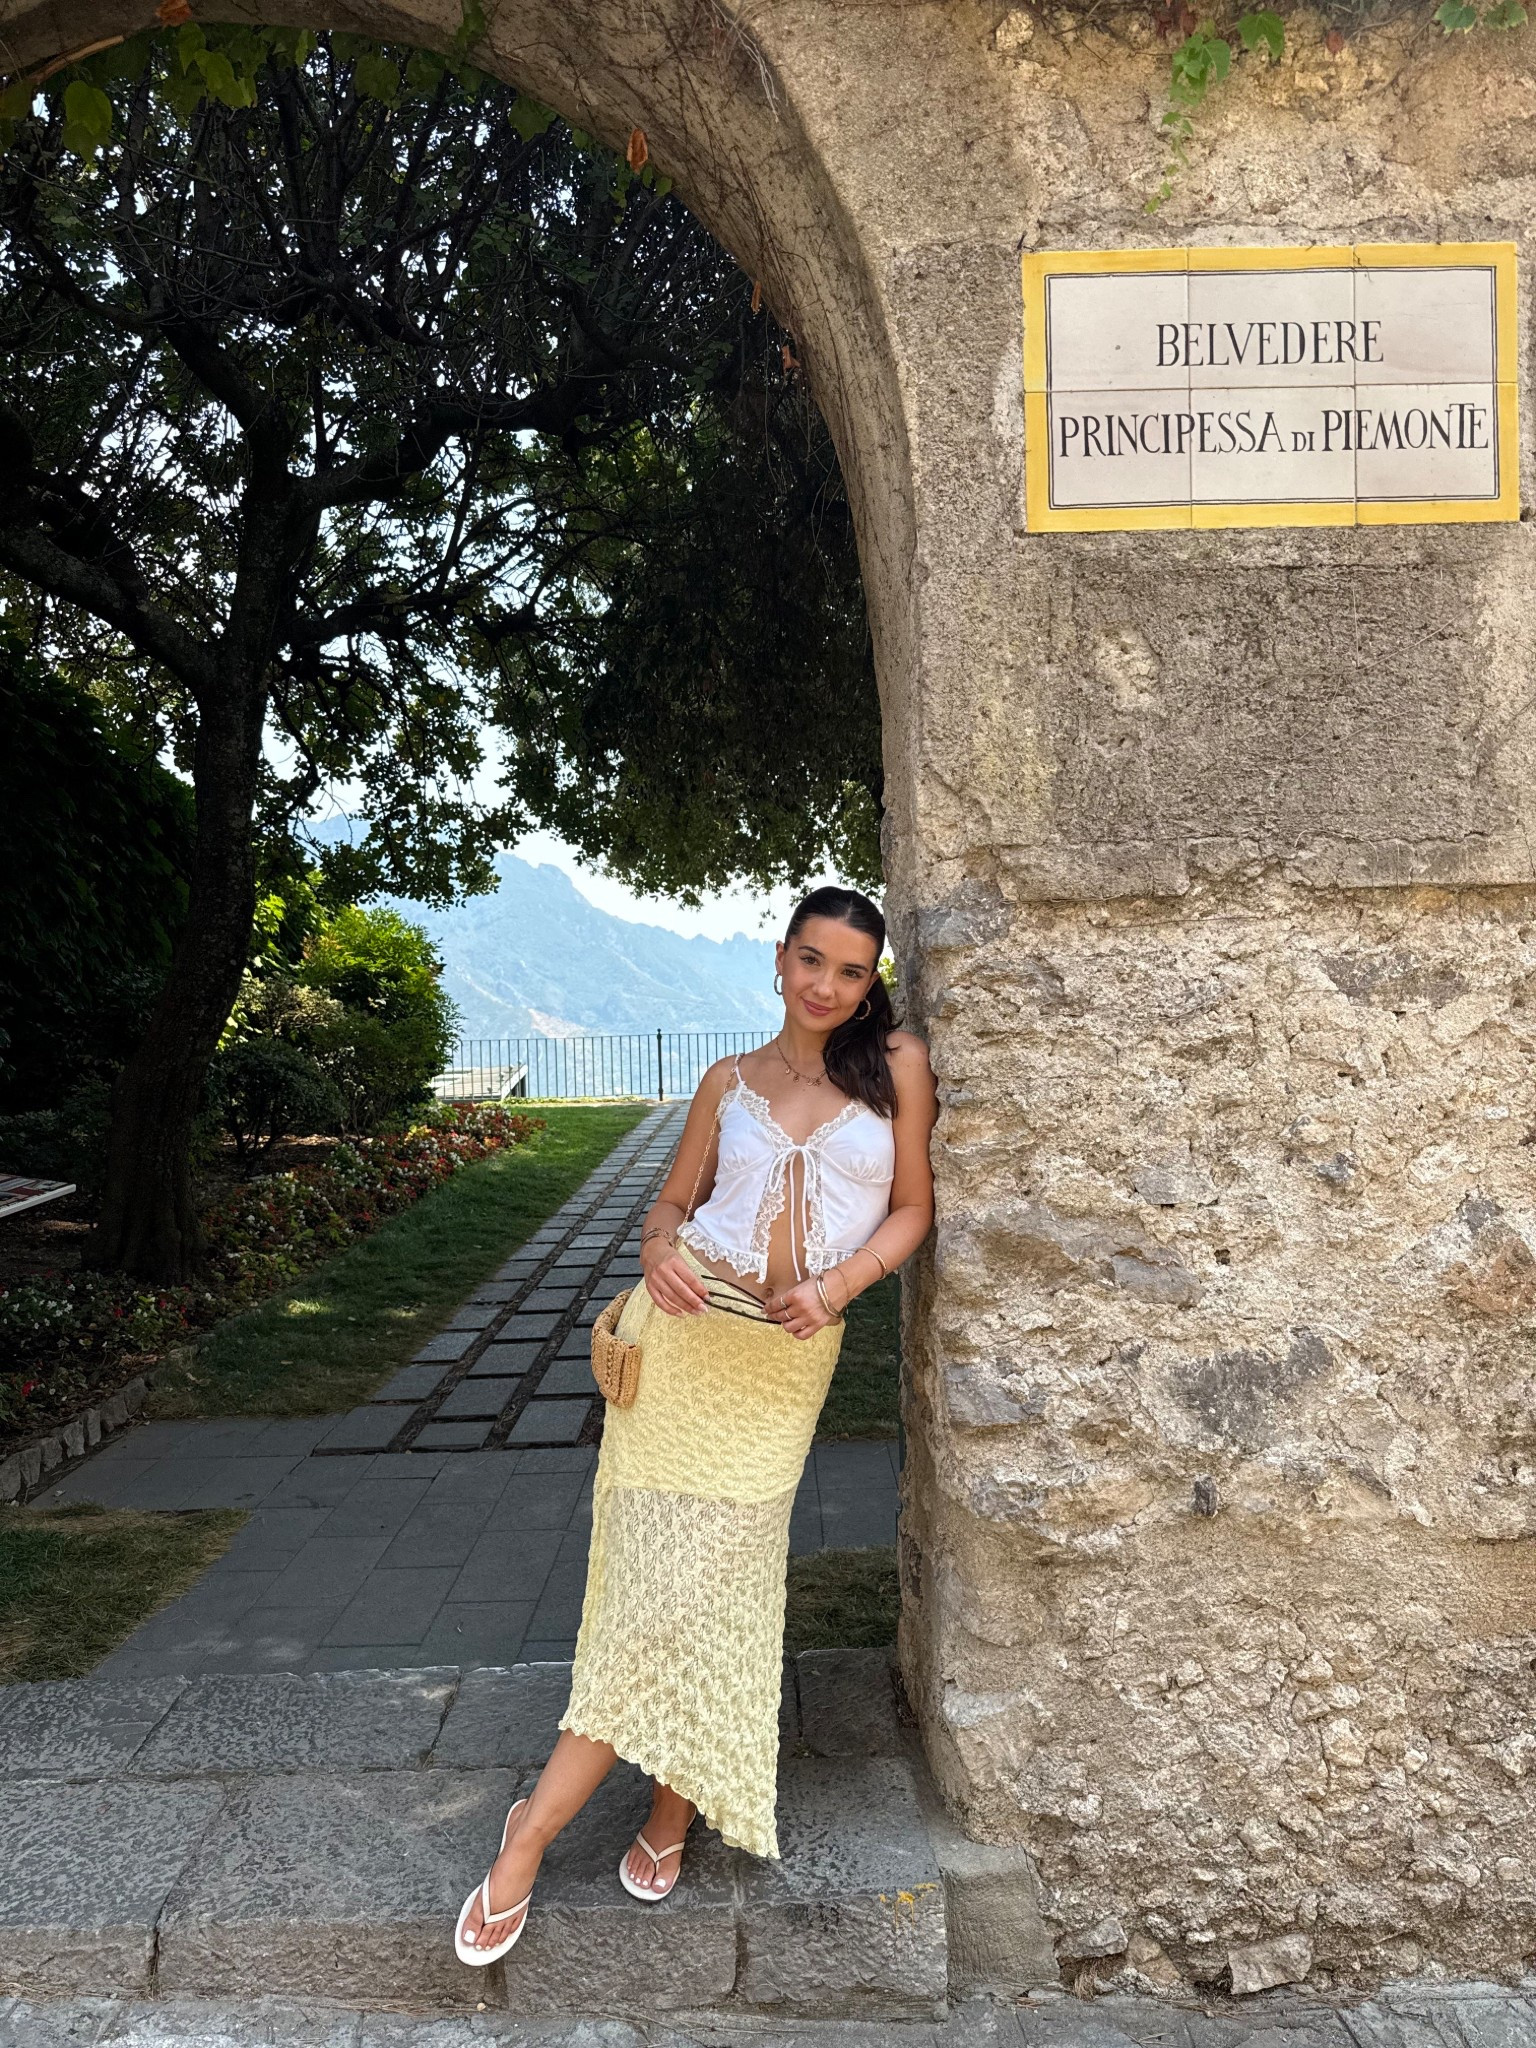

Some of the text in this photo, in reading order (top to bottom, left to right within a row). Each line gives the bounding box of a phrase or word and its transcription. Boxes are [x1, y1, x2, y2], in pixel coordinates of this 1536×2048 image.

[1155, 320, 1384, 367] BELVEDERE
[1059, 402, 1489, 457] PRINCIPESSA DI PIEMONTE
